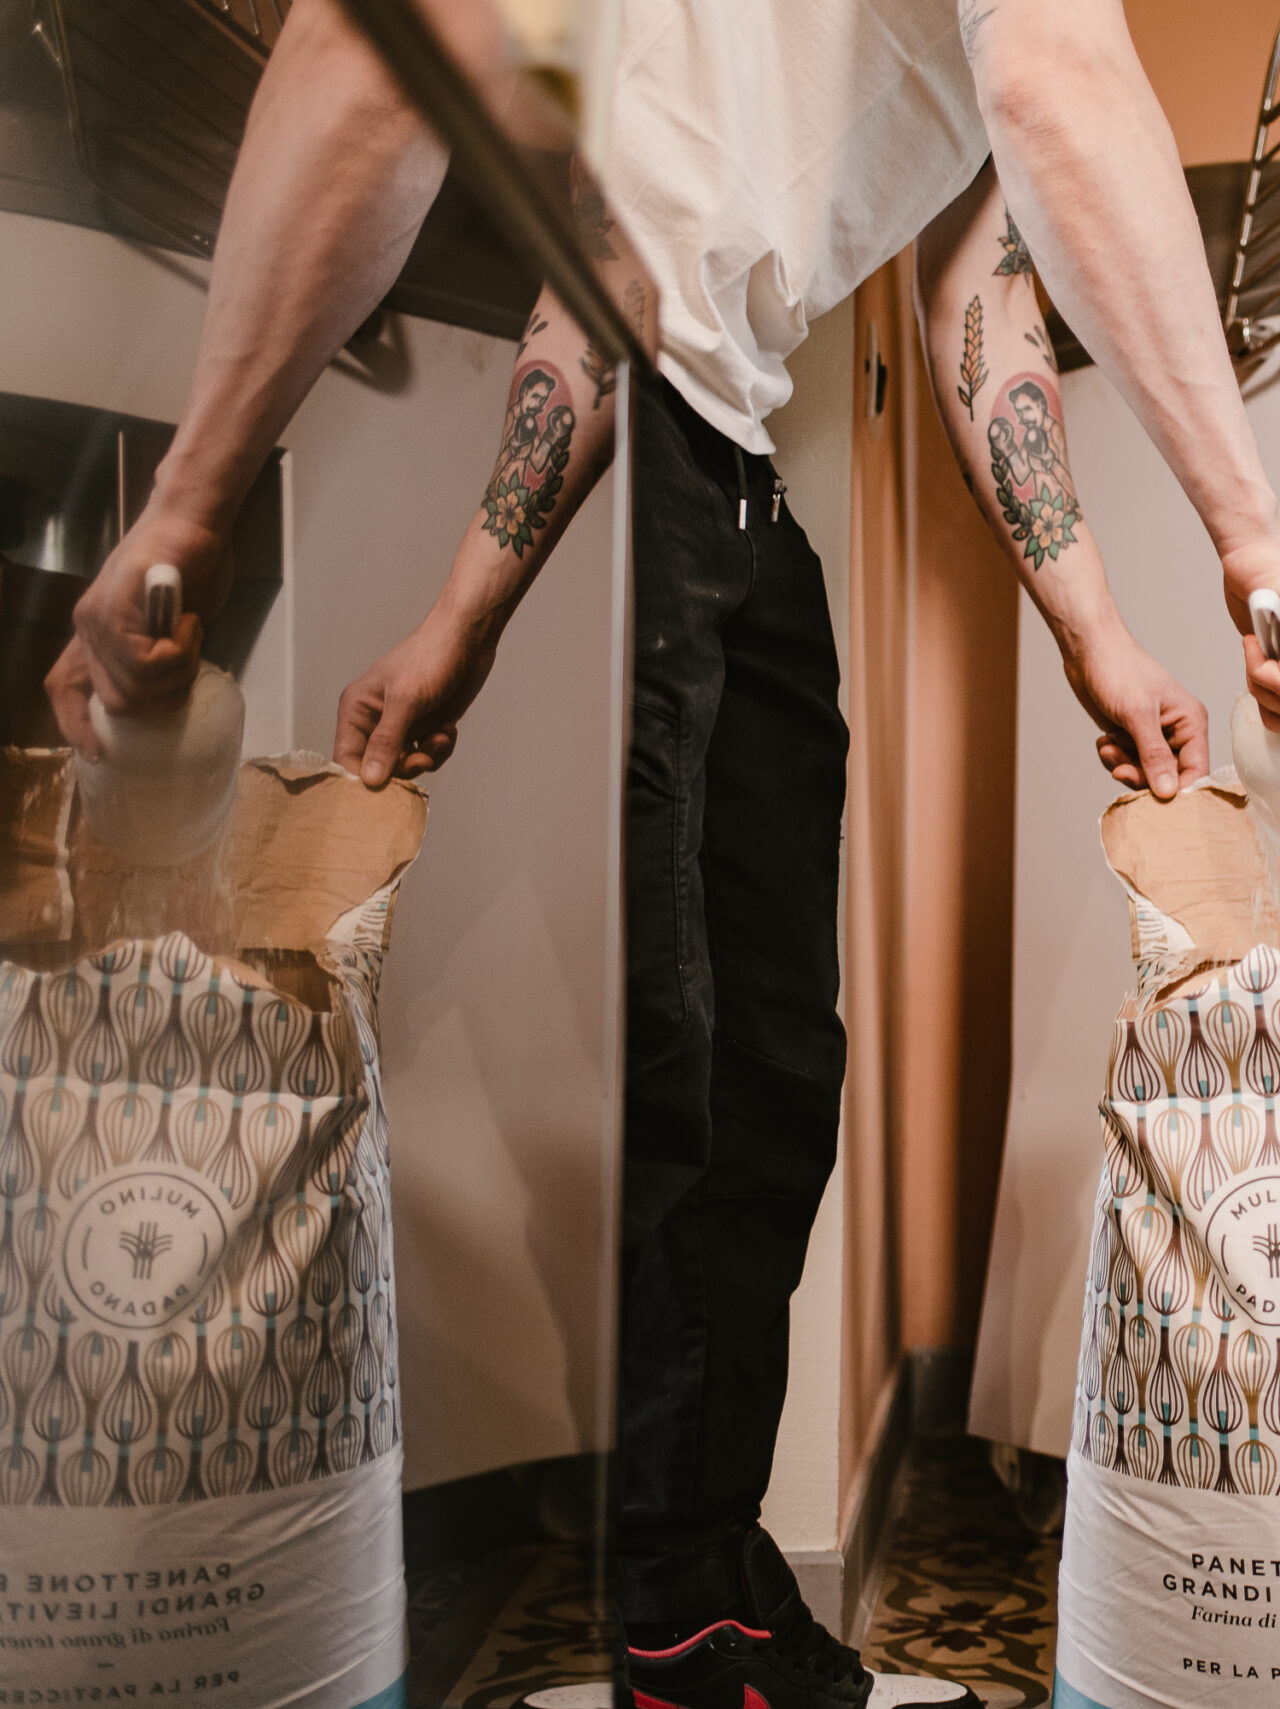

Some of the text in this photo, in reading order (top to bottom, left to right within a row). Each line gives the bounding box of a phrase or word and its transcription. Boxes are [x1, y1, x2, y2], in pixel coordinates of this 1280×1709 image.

[1162, 1573, 1272, 1602] GRANDI
[1191, 1606, 1252, 1627] Farina
[1258, 1613, 1277, 1629] di
[1183, 1658, 1221, 1675] PER
[1233, 1664, 1260, 1679] LA
